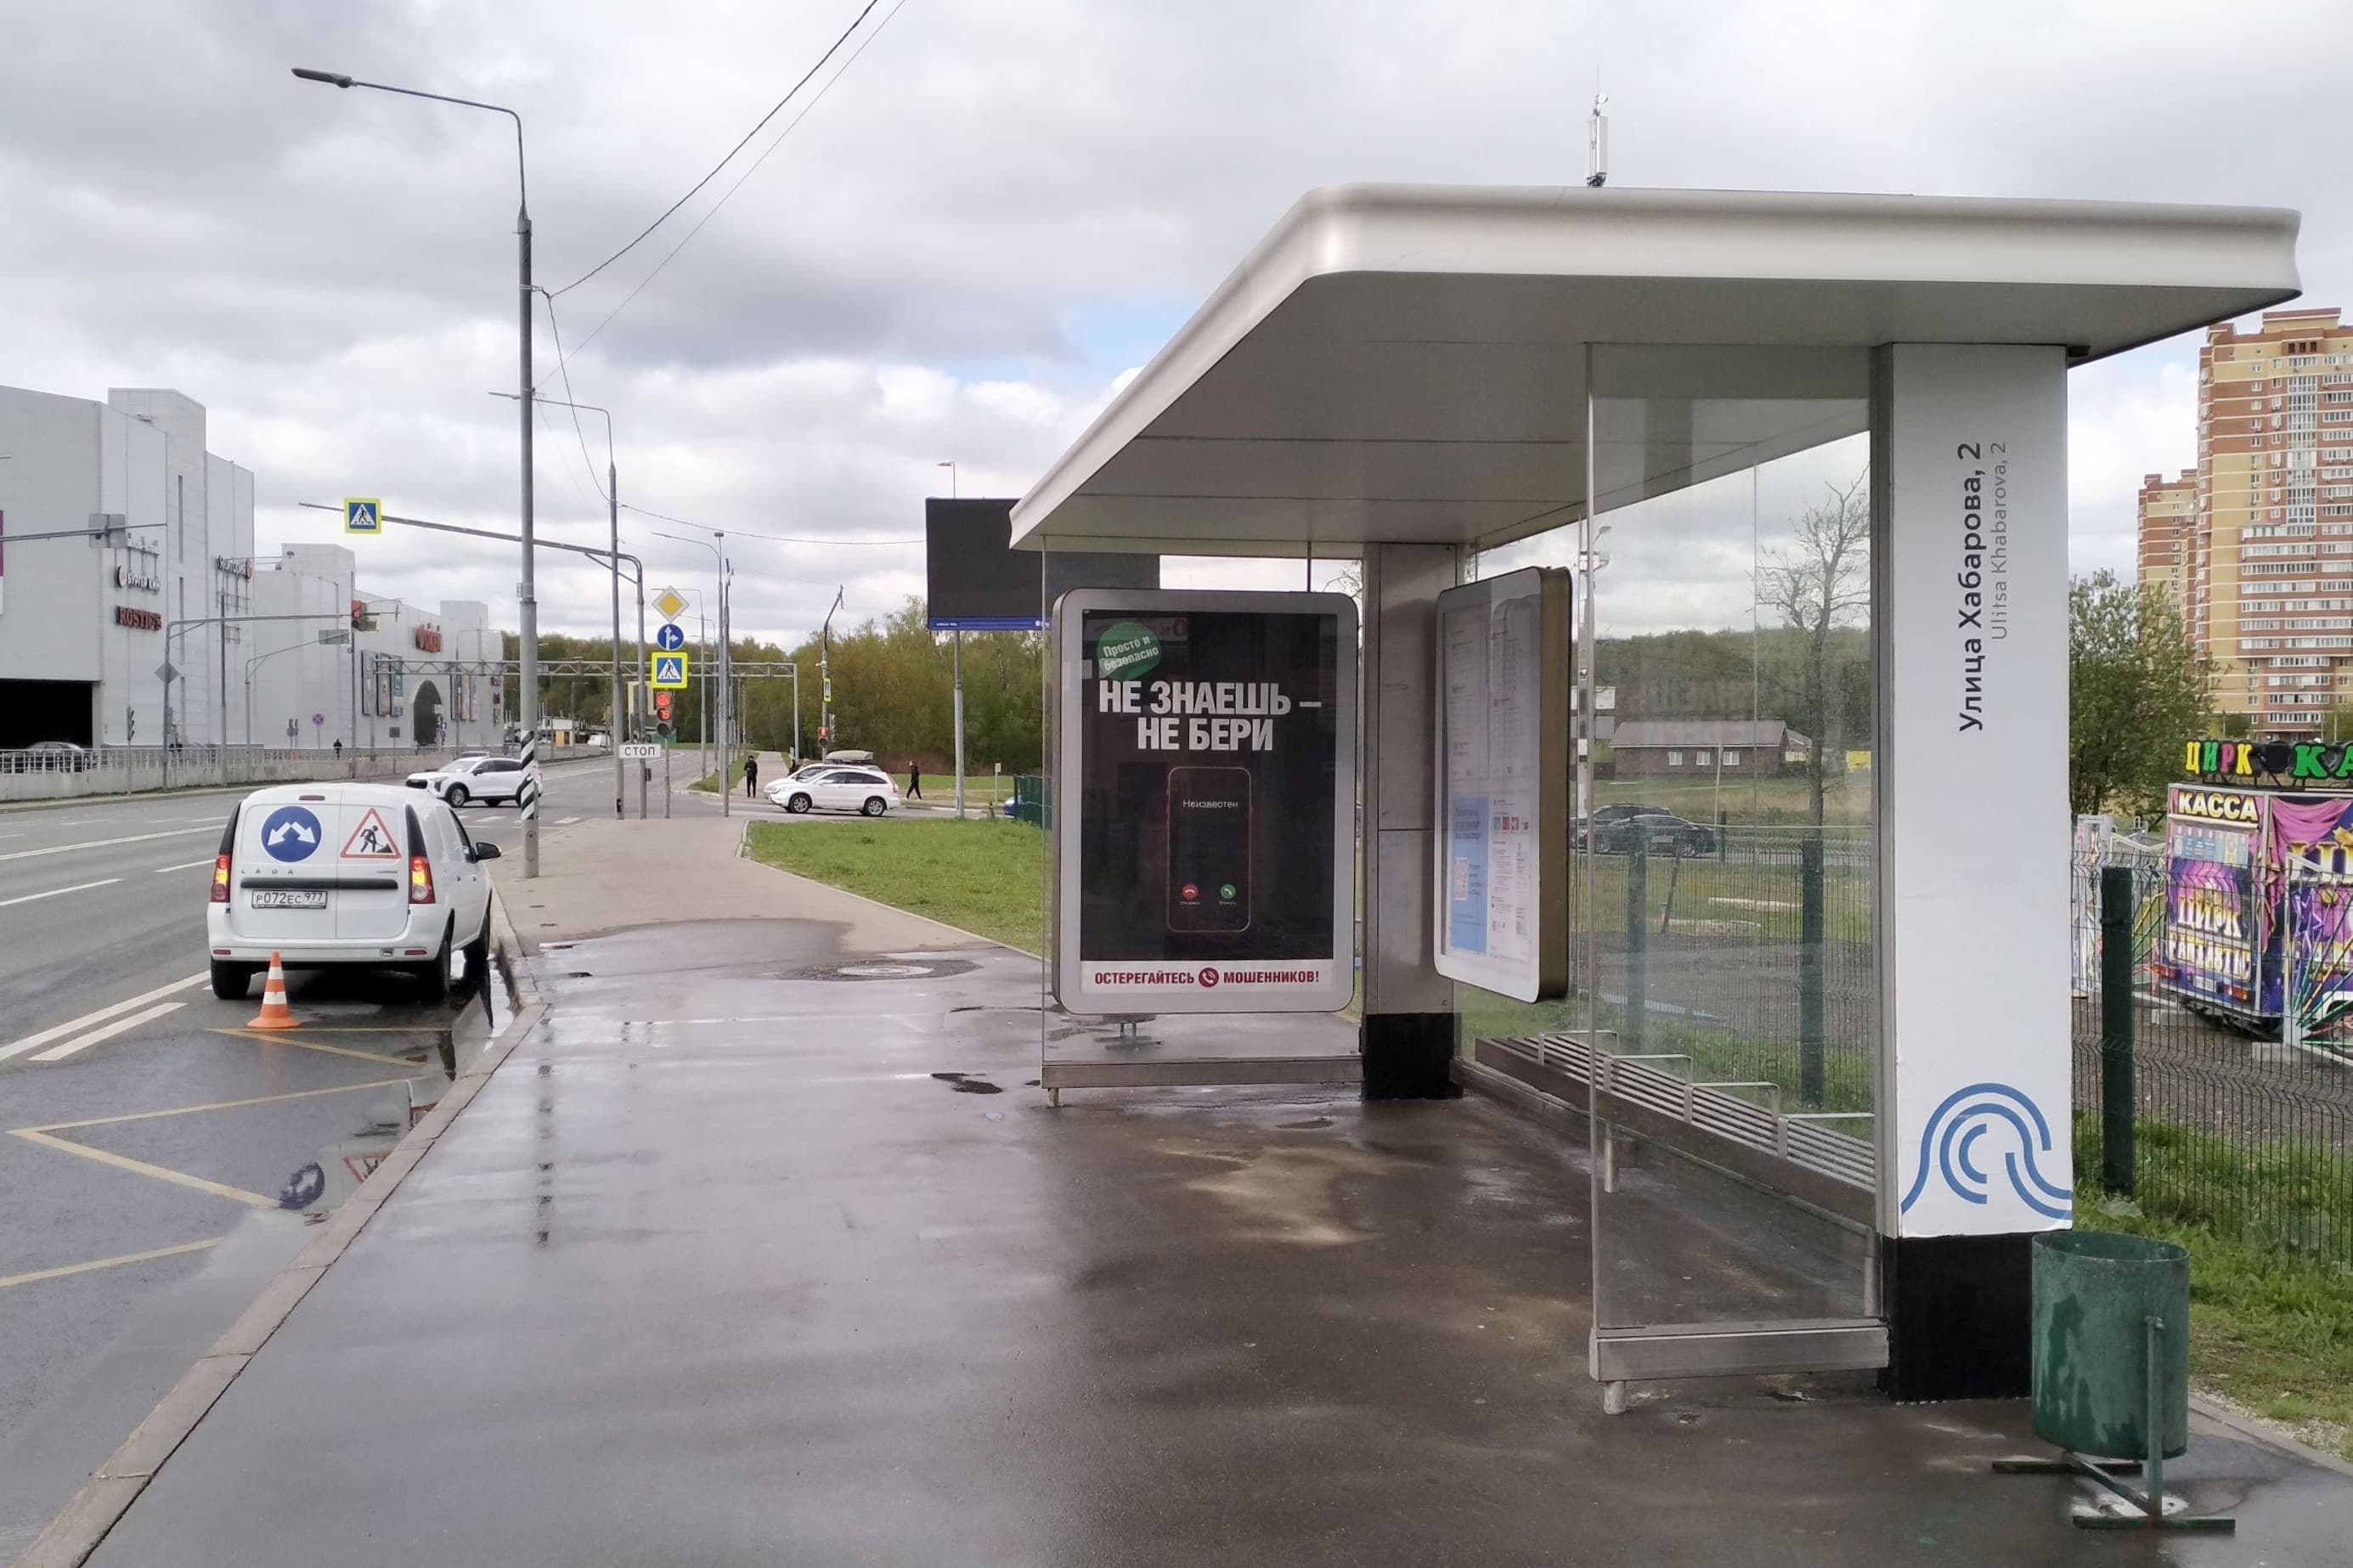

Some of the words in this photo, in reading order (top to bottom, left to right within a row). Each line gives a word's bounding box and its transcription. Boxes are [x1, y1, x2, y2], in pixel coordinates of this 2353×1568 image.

[1957, 442, 1981, 460] 2
[1990, 442, 2006, 454] 2
[1990, 460, 2008, 573] Khabarova,
[1957, 470, 1987, 629] Хабарова,
[1990, 580, 2007, 640] Ulitsa
[1103, 640, 1141, 657] Просто
[1142, 635, 1150, 646] и
[1103, 646, 1160, 671] безопасно
[1099, 680, 1143, 713] НЕ
[1149, 680, 1292, 715] ЗНАЕШЬ
[1959, 638, 1986, 732] Улица
[1137, 717, 1180, 750] НЕ
[1188, 718, 1273, 751] БЕРИ
[624, 747, 655, 756] СТОП
[2185, 742, 2253, 775] ЦИРК
[1182, 798, 1239, 809] Неизвестен
[2177, 791, 2259, 821] КАССА
[1095, 970, 1195, 984] ОСТЕРЕГАЙТЕСЬ
[1223, 971, 1319, 984] МОШЕННИКОВ!
